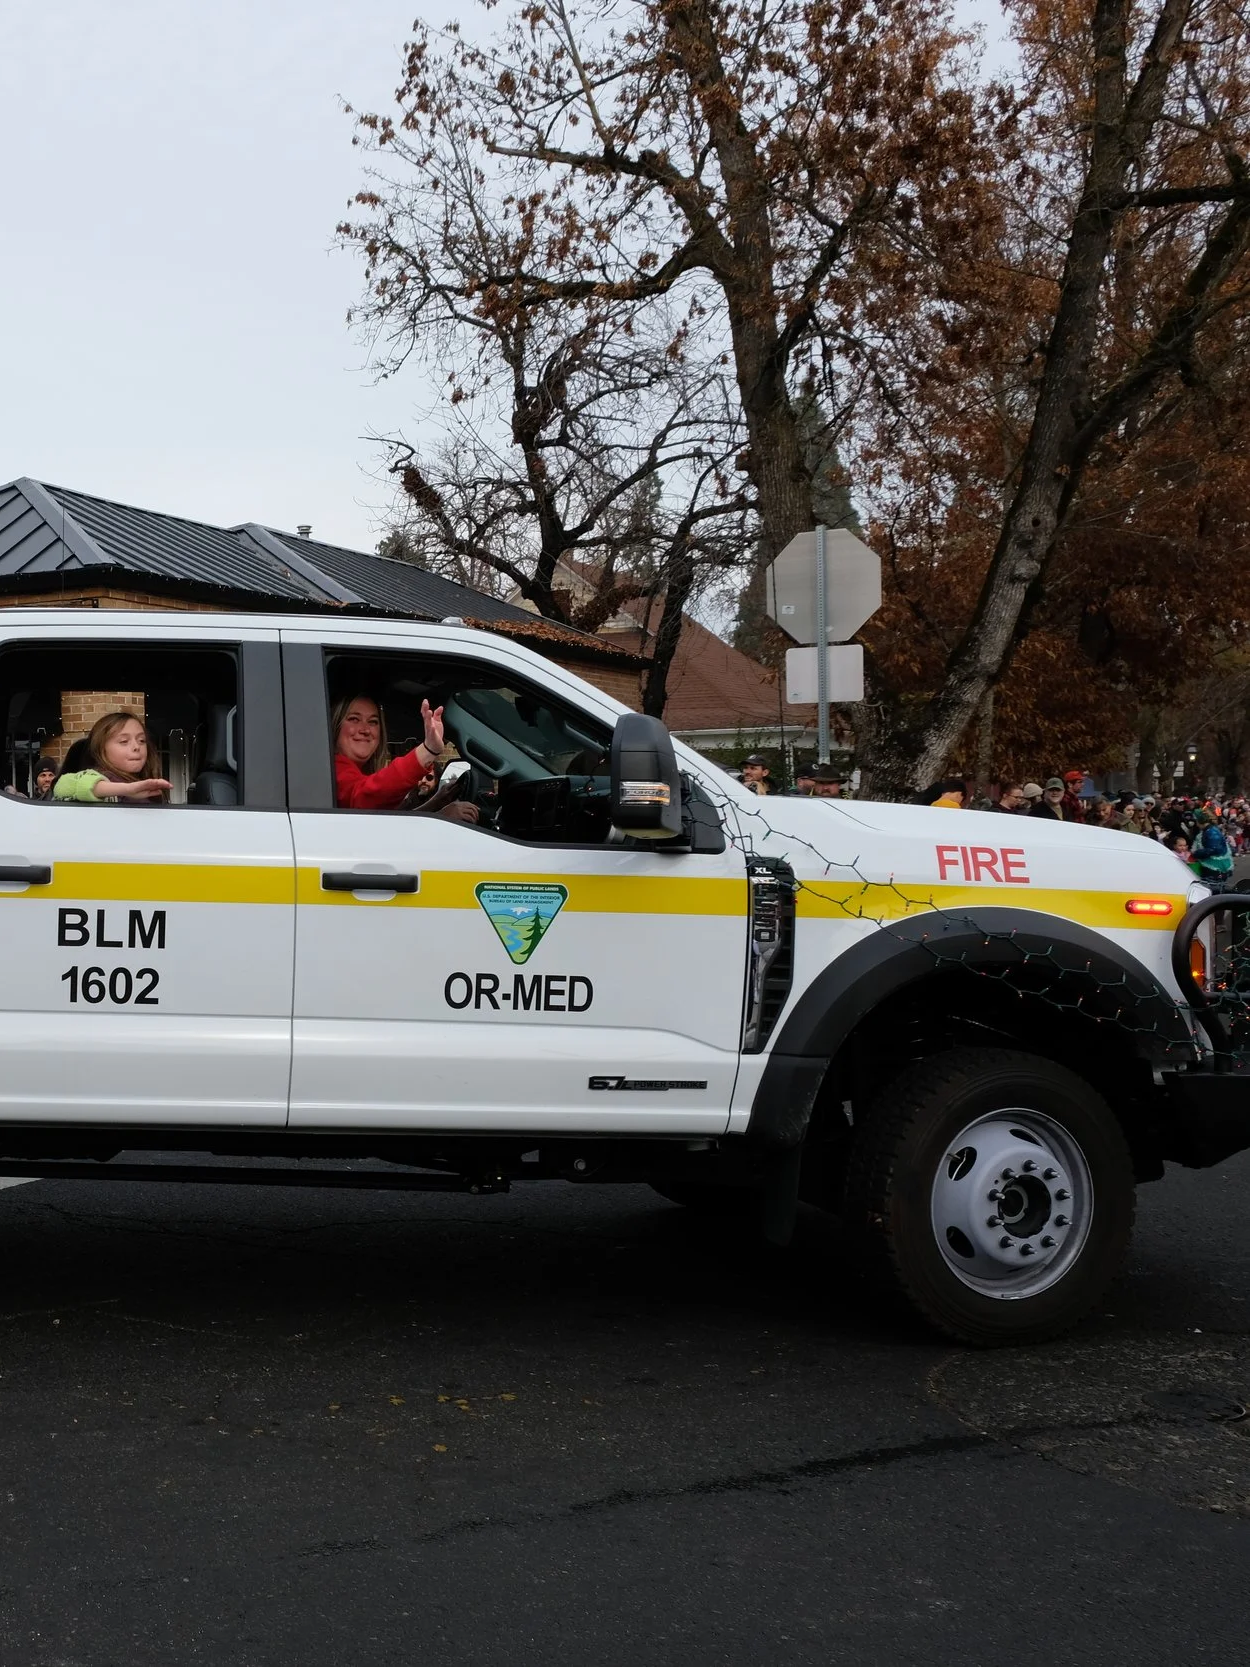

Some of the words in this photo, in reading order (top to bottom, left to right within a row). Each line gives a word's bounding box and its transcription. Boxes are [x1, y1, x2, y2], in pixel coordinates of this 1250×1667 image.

[754, 866, 772, 874] XL
[935, 844, 1030, 884] FIRE
[57, 908, 167, 949] BLM
[61, 966, 160, 1005] 1602
[444, 972, 594, 1013] OR-MED
[633, 1080, 667, 1089] POWER
[668, 1081, 707, 1089] STROKE
